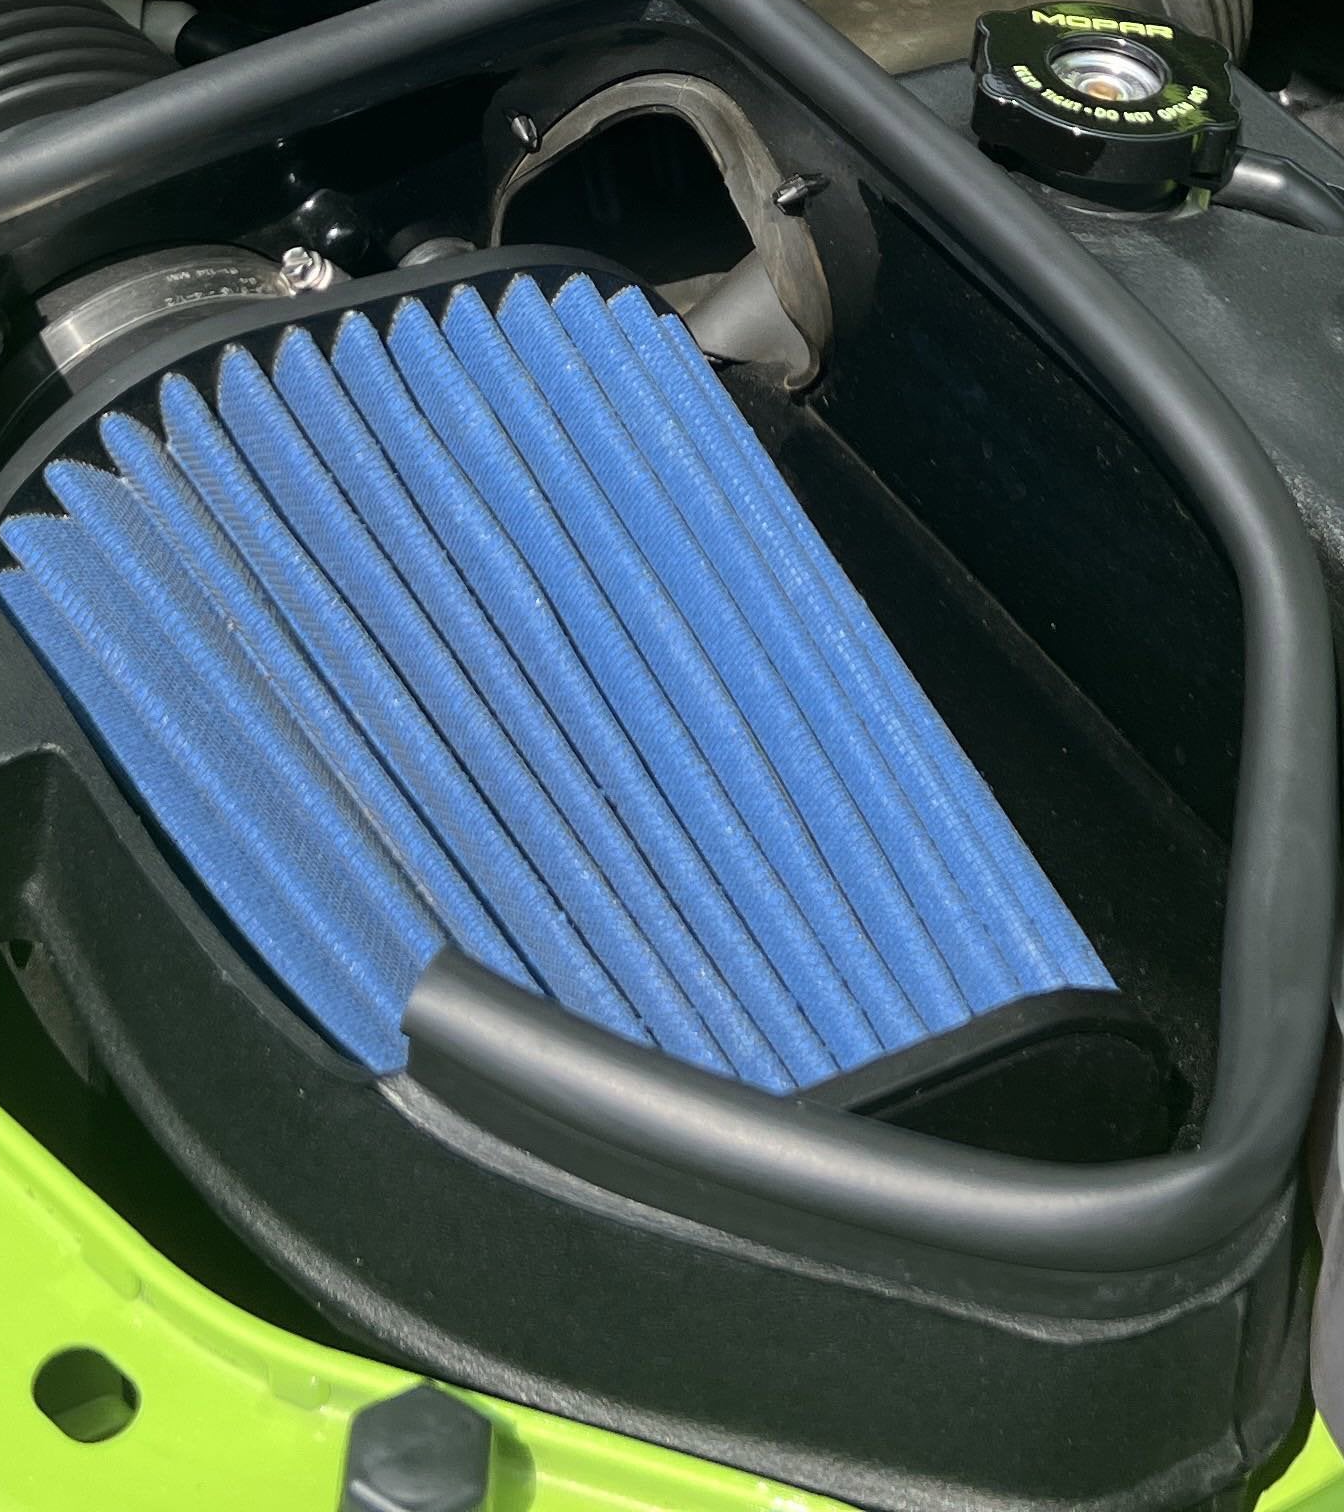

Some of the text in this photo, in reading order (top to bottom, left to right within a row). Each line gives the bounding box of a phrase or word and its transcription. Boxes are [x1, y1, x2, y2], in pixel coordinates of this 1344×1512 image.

[1031, 10, 1174, 39] MOPAR
[1094, 106, 1120, 122] DO
[1123, 111, 1154, 123] NOT
